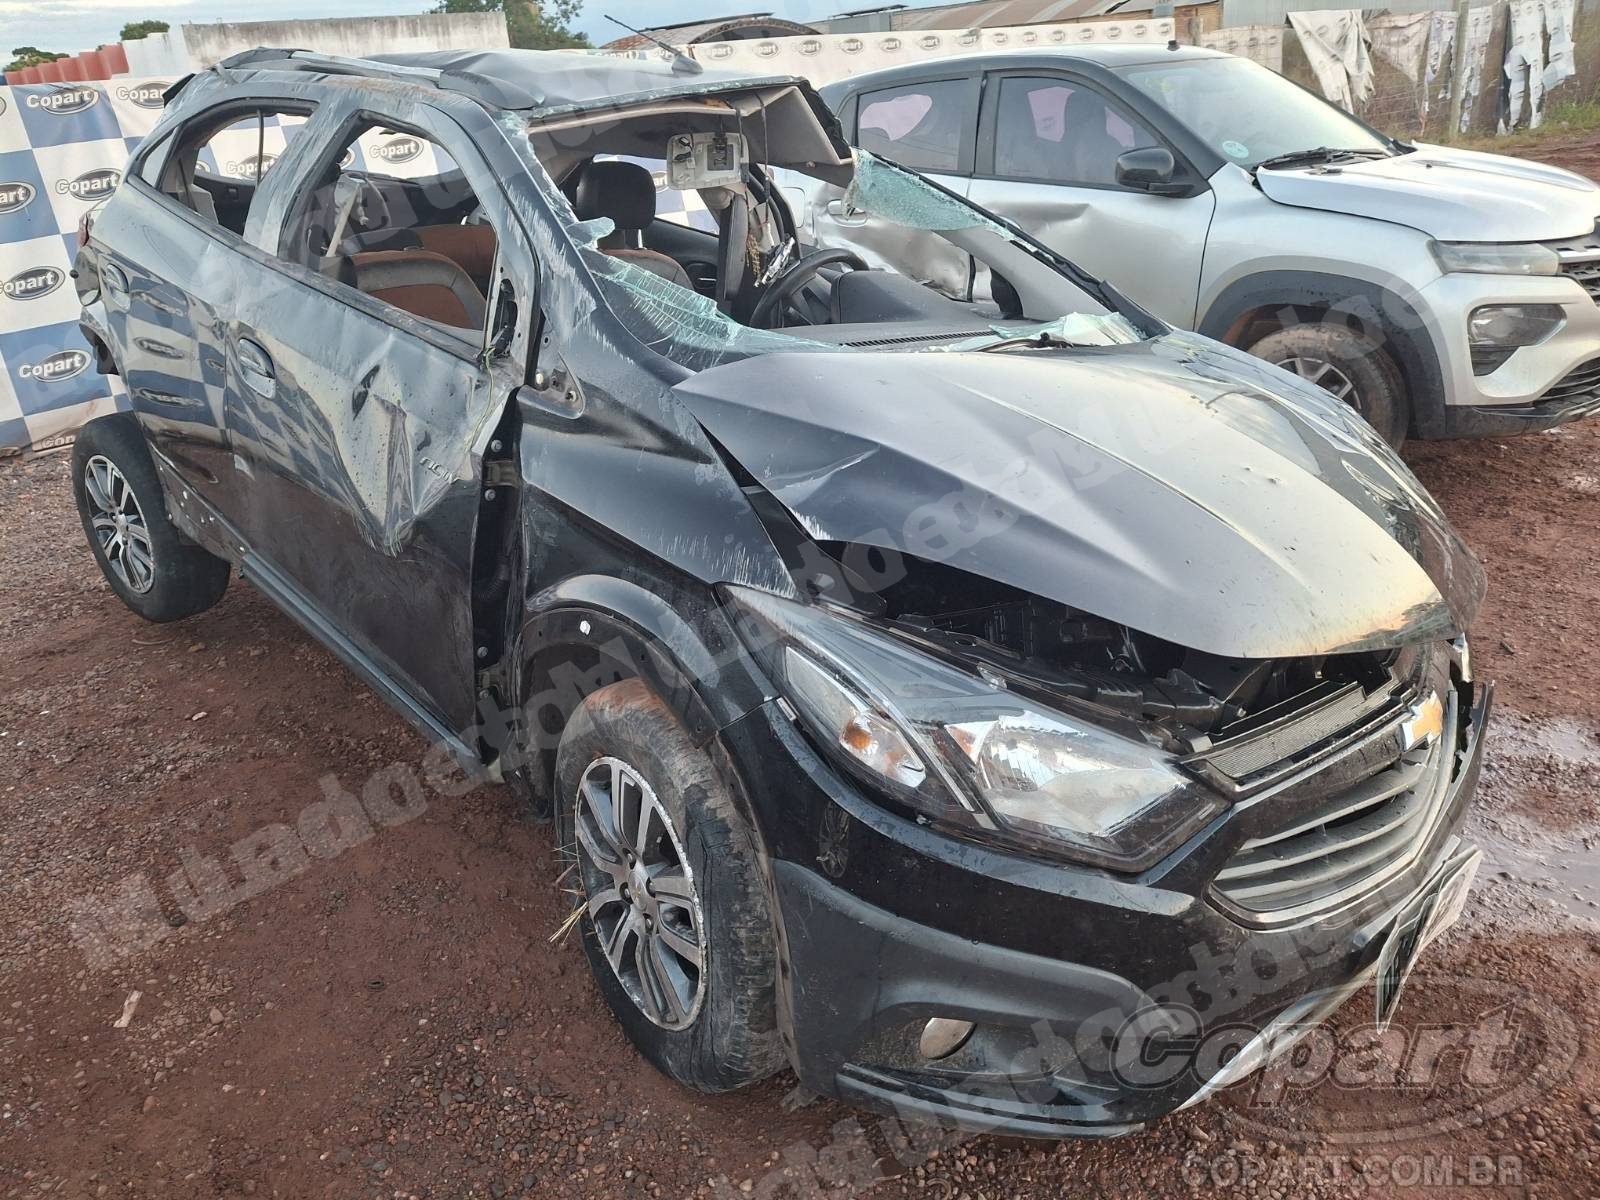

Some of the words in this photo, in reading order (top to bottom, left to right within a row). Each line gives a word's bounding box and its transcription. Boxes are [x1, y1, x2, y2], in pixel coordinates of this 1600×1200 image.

[26, 87, 91, 109] Copart
[116, 86, 164, 103] Copa
[369, 141, 418, 161] Copart
[0, 186, 25, 203] art
[56, 173, 119, 196] Copart
[18, 354, 82, 379] Copart
